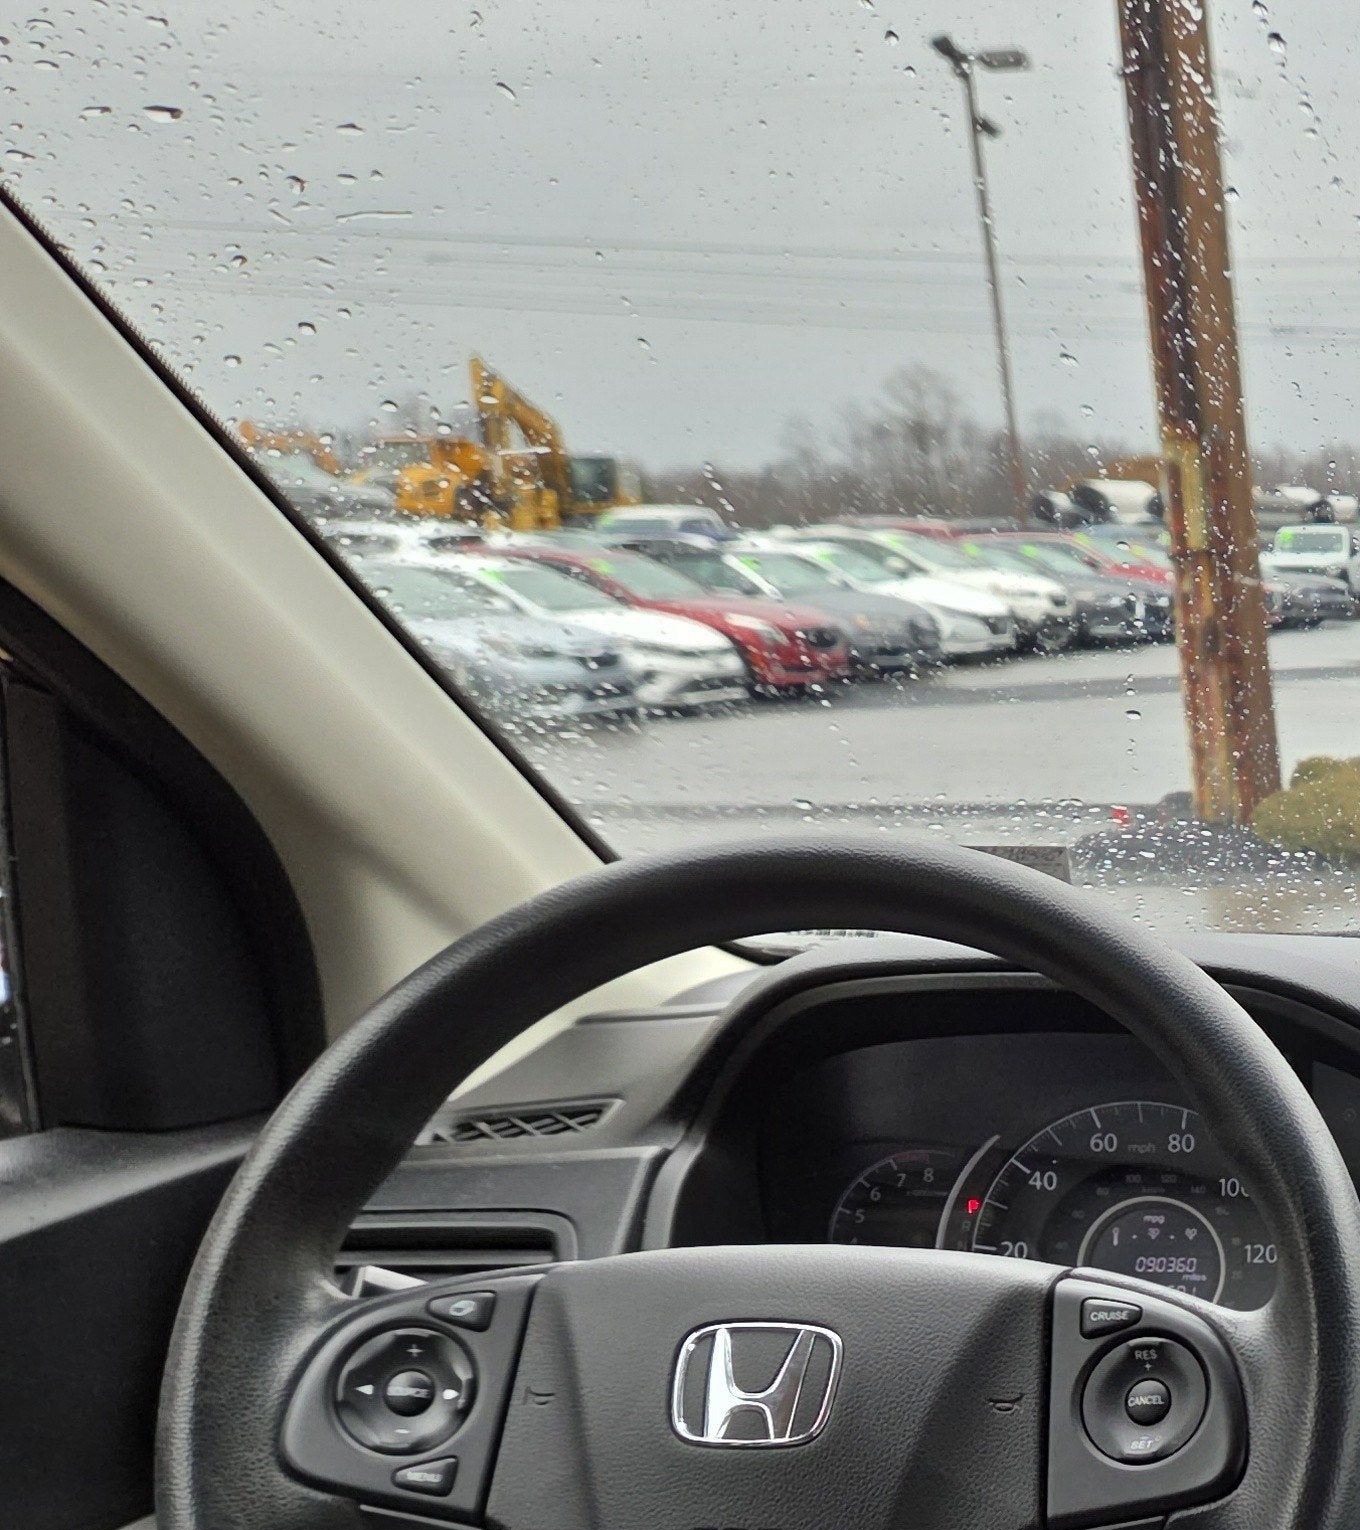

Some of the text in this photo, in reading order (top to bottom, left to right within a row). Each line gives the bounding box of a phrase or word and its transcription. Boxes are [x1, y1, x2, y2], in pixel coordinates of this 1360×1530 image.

[1090, 1133, 1118, 1152] 60
[1167, 1133, 1195, 1153] 80
[923, 1168, 934, 1182] 8
[1028, 1171, 1058, 1191] 40
[870, 1187, 882, 1201] 6
[968, 1199, 979, 1214] P
[854, 1208, 865, 1224] 5
[1001, 1241, 1028, 1260] 20
[1244, 1244, 1278, 1264] 120
[1135, 1256, 1197, 1273] 090360
[1090, 1311, 1129, 1322] CRUISE
[1134, 1350, 1158, 1360] RES
[1127, 1395, 1164, 1407] CANCEL
